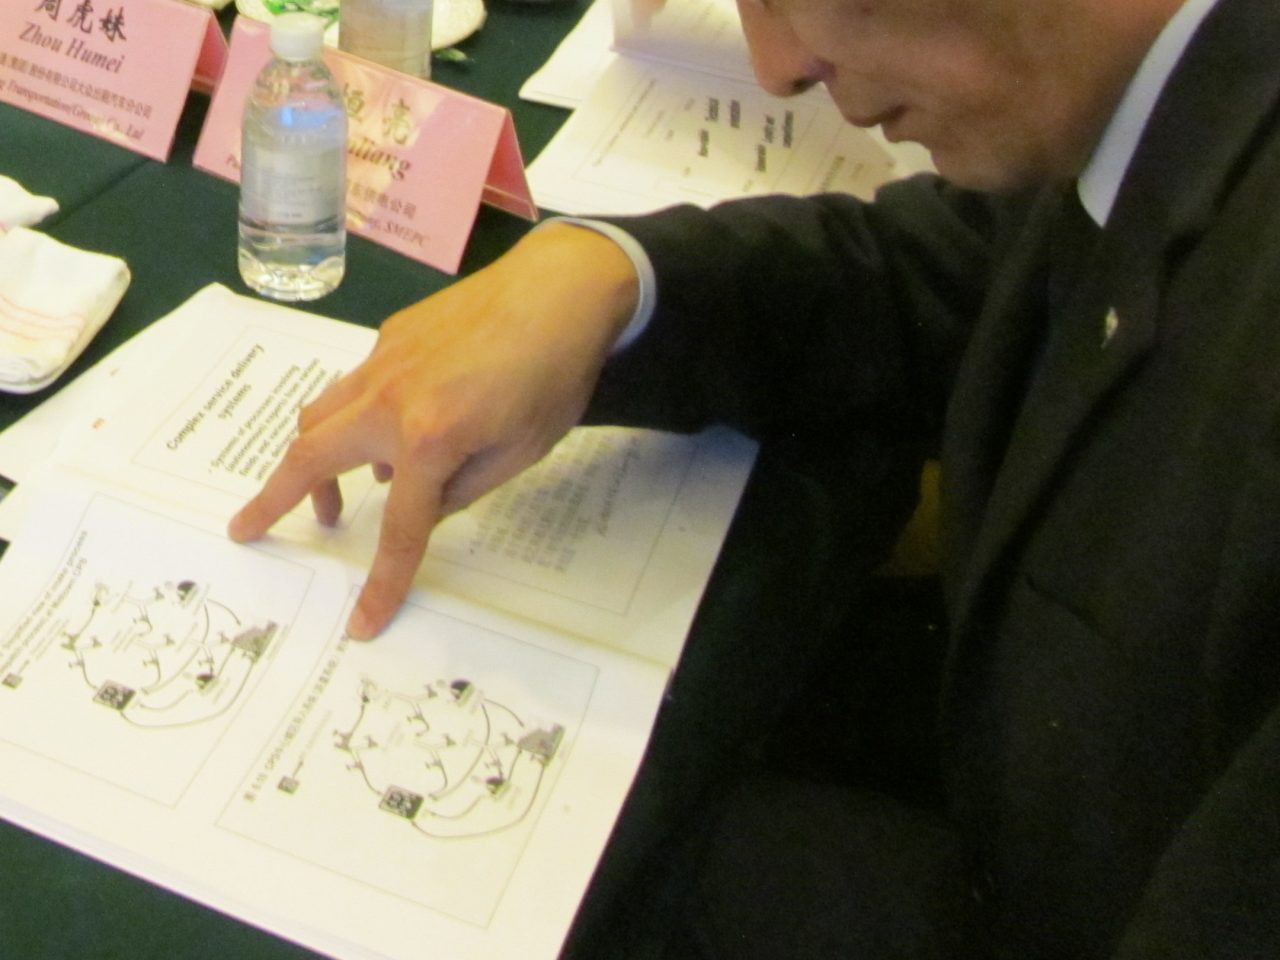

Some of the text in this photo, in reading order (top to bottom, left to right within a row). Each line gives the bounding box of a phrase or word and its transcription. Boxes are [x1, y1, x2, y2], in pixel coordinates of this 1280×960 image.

[19, 22, 127, 74] Zhou Humei
[167, 344, 264, 449] Complex service delivery
[218, 384, 251, 418] systems
